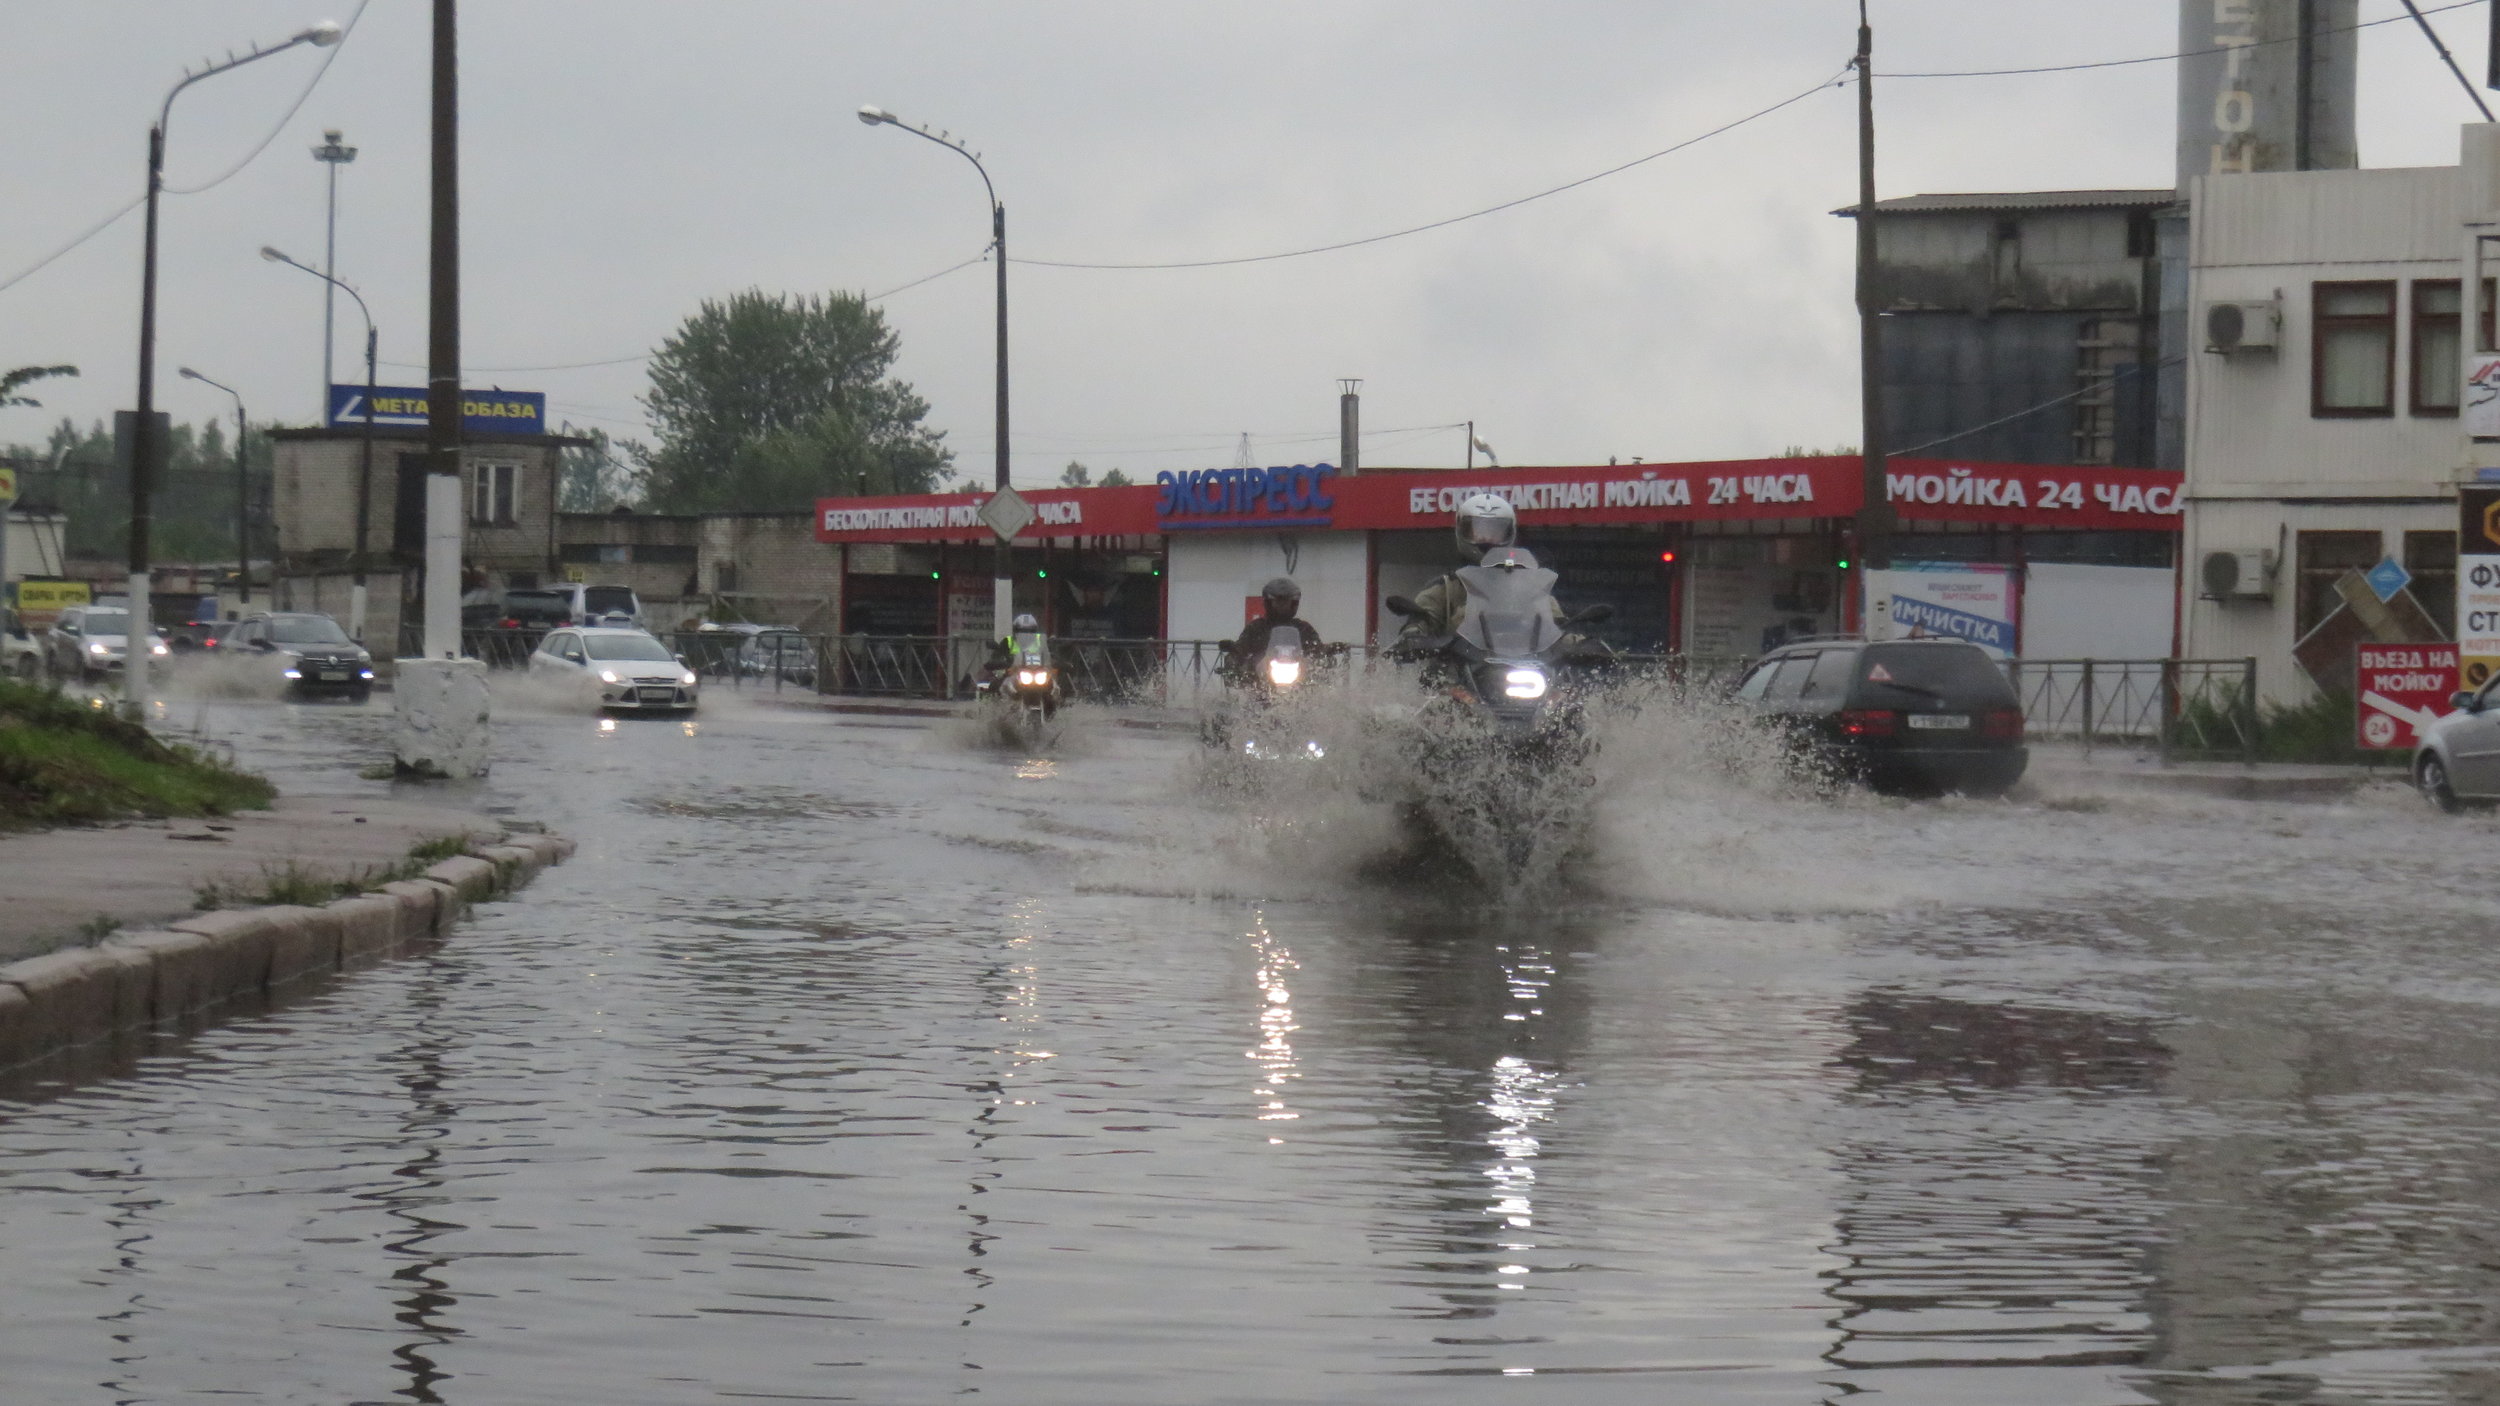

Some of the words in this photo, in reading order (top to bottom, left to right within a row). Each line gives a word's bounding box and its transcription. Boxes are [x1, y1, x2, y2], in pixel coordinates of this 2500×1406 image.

[372, 397, 537, 418] МЕТАОБАЗА
[1157, 463, 1334, 516] ЭКСПРЕСС
[1410, 481, 1600, 513] БЕСКАКТНАЯ
[1604, 472, 1691, 507] МОЙКА
[1707, 477, 1739, 504] 24
[1743, 474, 1814, 503] ЧАСА
[1886, 468, 2027, 507] МОЙКА
[2036, 480, 2084, 509] 24
[824, 506, 946, 531] БЕСКОНТАКТНАЯ
[1038, 501, 1082, 526] ЧАСА
[1893, 601, 1999, 644] ИМЧИСТКА
[2360, 650, 2424, 669] ВЪЕЗД
[2428, 650, 2457, 668] НА
[2373, 670, 2444, 692] МОЙКУ
[2370, 722, 2389, 736] 24
